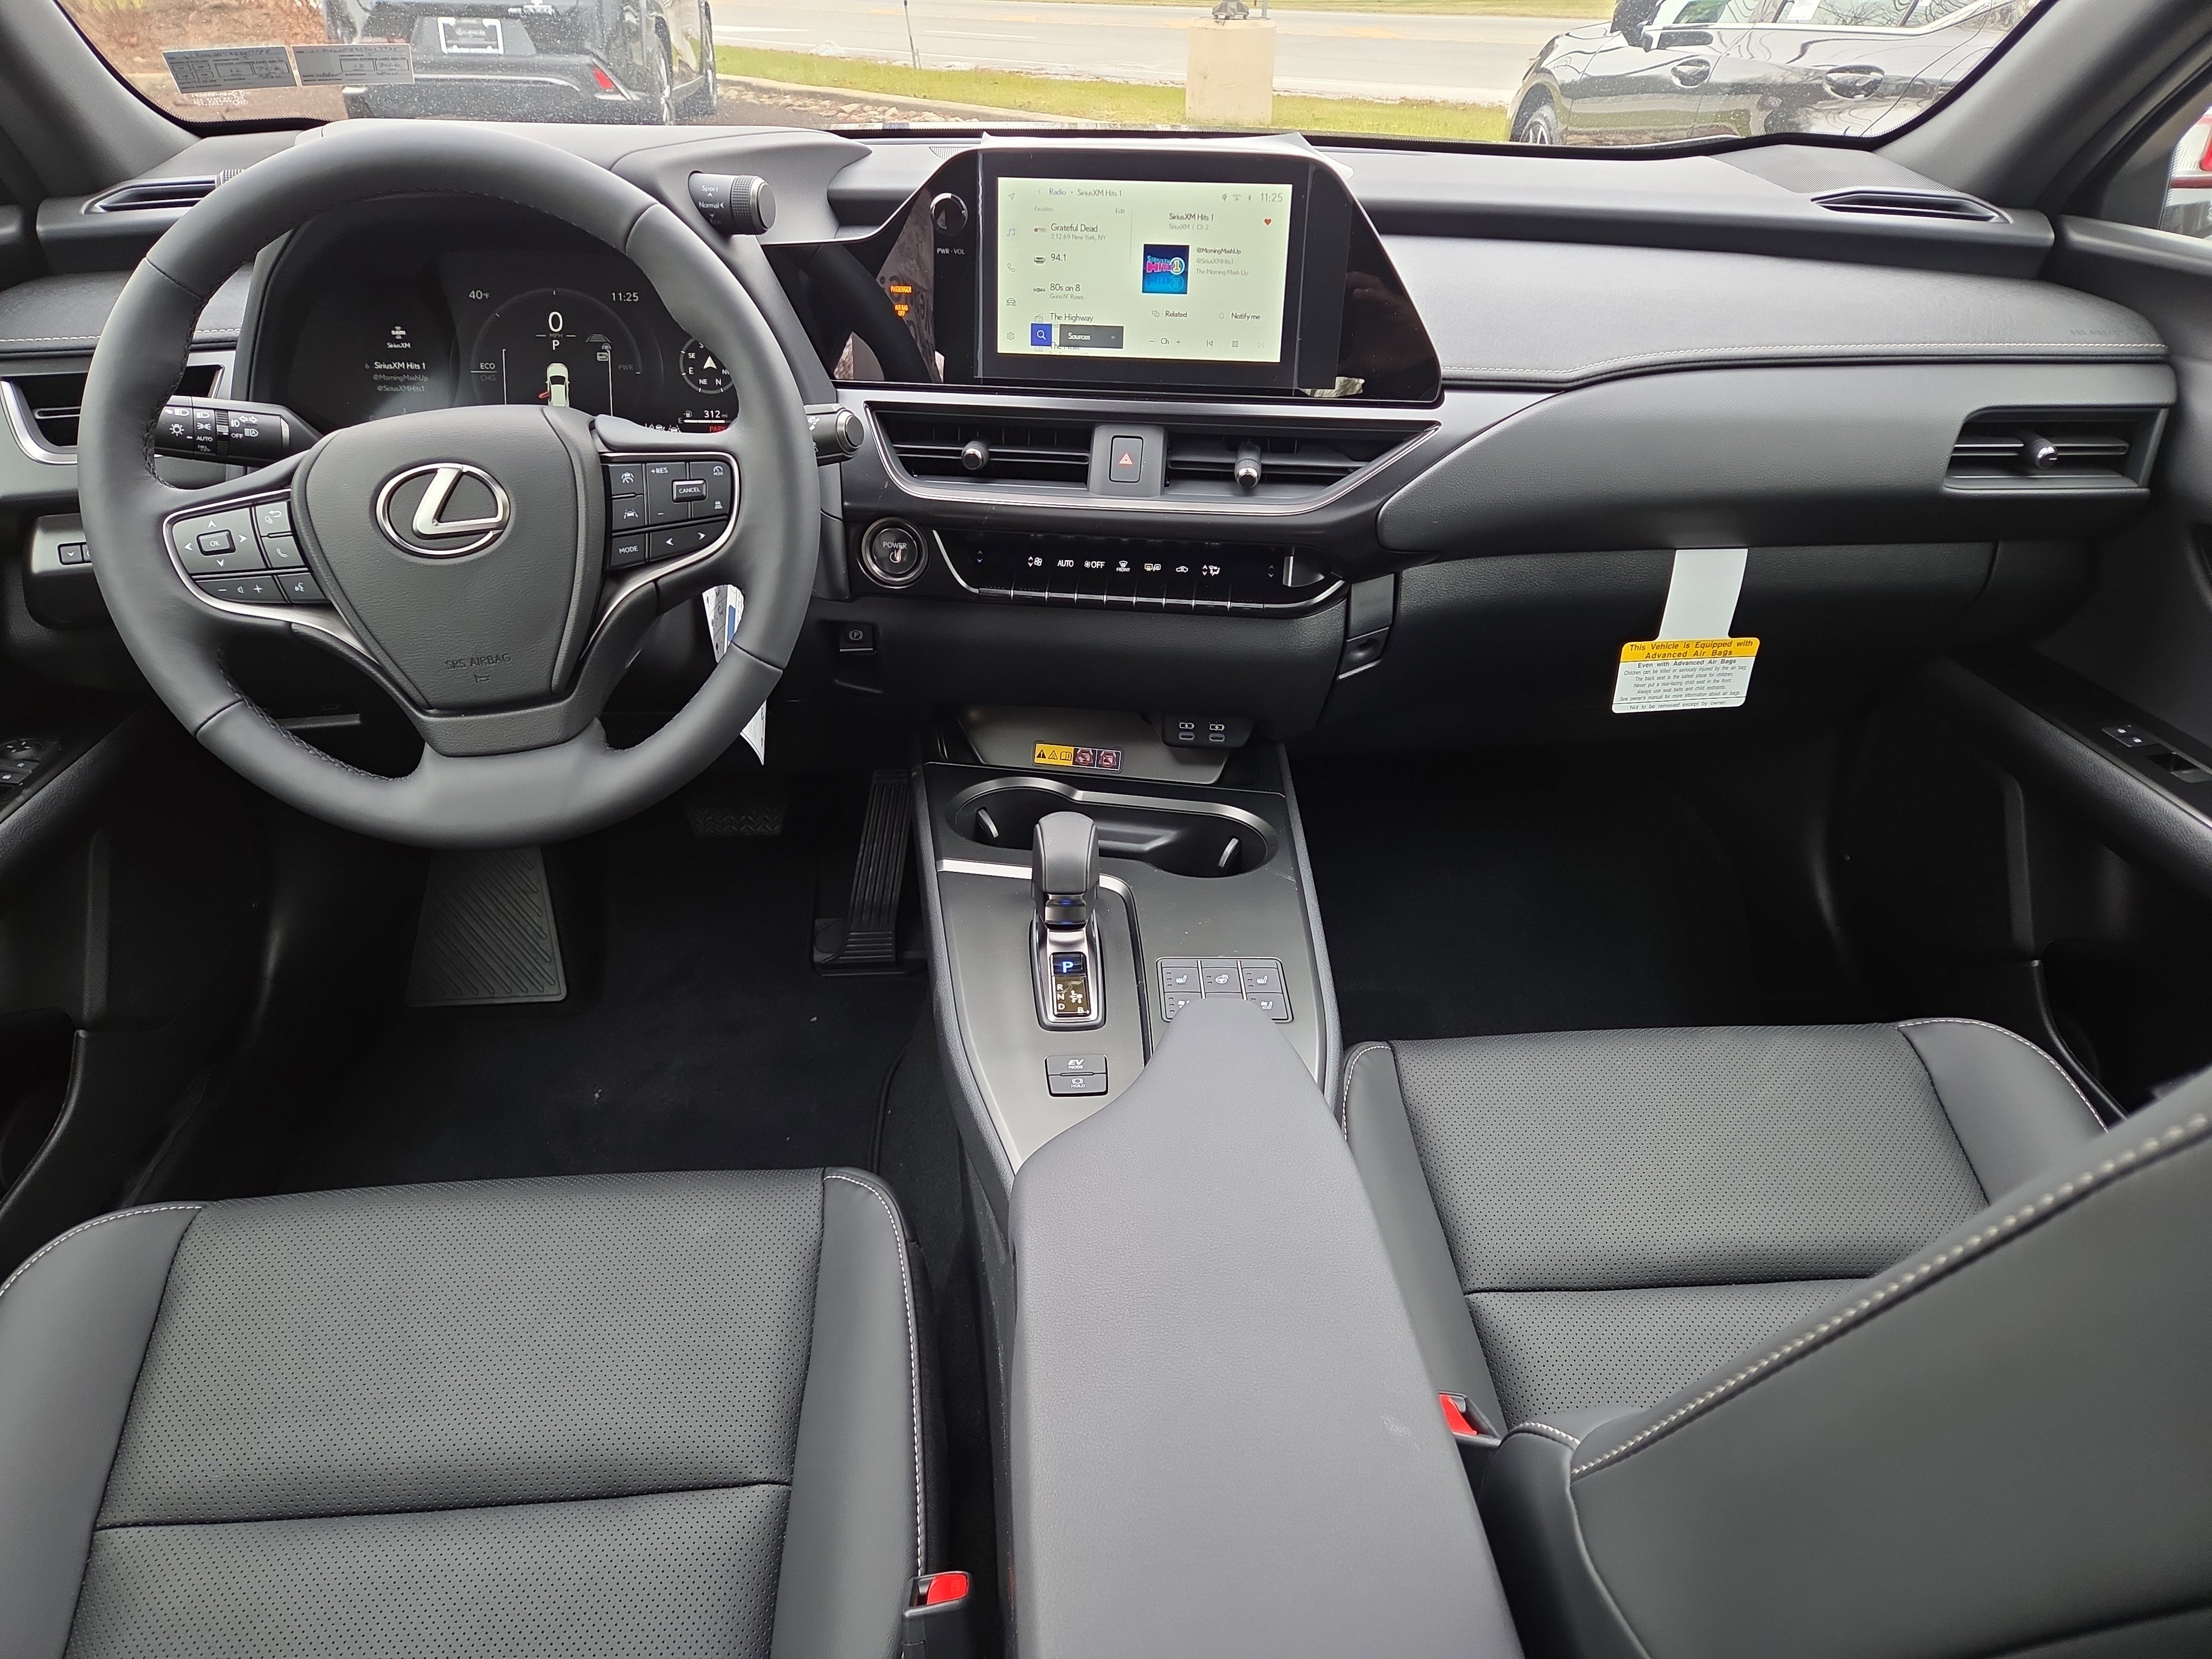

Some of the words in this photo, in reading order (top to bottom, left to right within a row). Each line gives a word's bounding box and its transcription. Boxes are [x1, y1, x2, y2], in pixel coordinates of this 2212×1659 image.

[702, 185, 718, 193] Sport
[1261, 192, 1283, 202] 11:25
[1169, 213, 1196, 221] SiriusXM
[1197, 213, 1209, 221] Hits
[1051, 223, 1079, 232] Grateful
[1081, 223, 1098, 232] Dead
[1051, 253, 1066, 261] 94.1
[1050, 283, 1063, 291] 80s
[611, 292, 639, 301] 11:25
[1049, 312, 1063, 320] The
[1064, 313, 1094, 323] Highway
[1231, 312, 1250, 320] Notify
[548, 311, 563, 332] 0
[1068, 332, 1091, 340] Sources
[552, 339, 560, 351] P
[374, 361, 405, 369] SiriusXM
[372, 374, 428, 382] @MorningMashUp
[704, 410, 721, 418] 312
[619, 545, 639, 554] MODE
[883, 542, 907, 550] POWER
[1057, 560, 1074, 568] AUTO
[1091, 561, 1105, 569] OFF
[1651, 642, 1679, 650] Vehicle
[1695, 640, 1733, 650] Equipped
[1645, 651, 1688, 659] Advanced
[470, 653, 512, 667] AIRBAG
[1063, 961, 1073, 973] P
